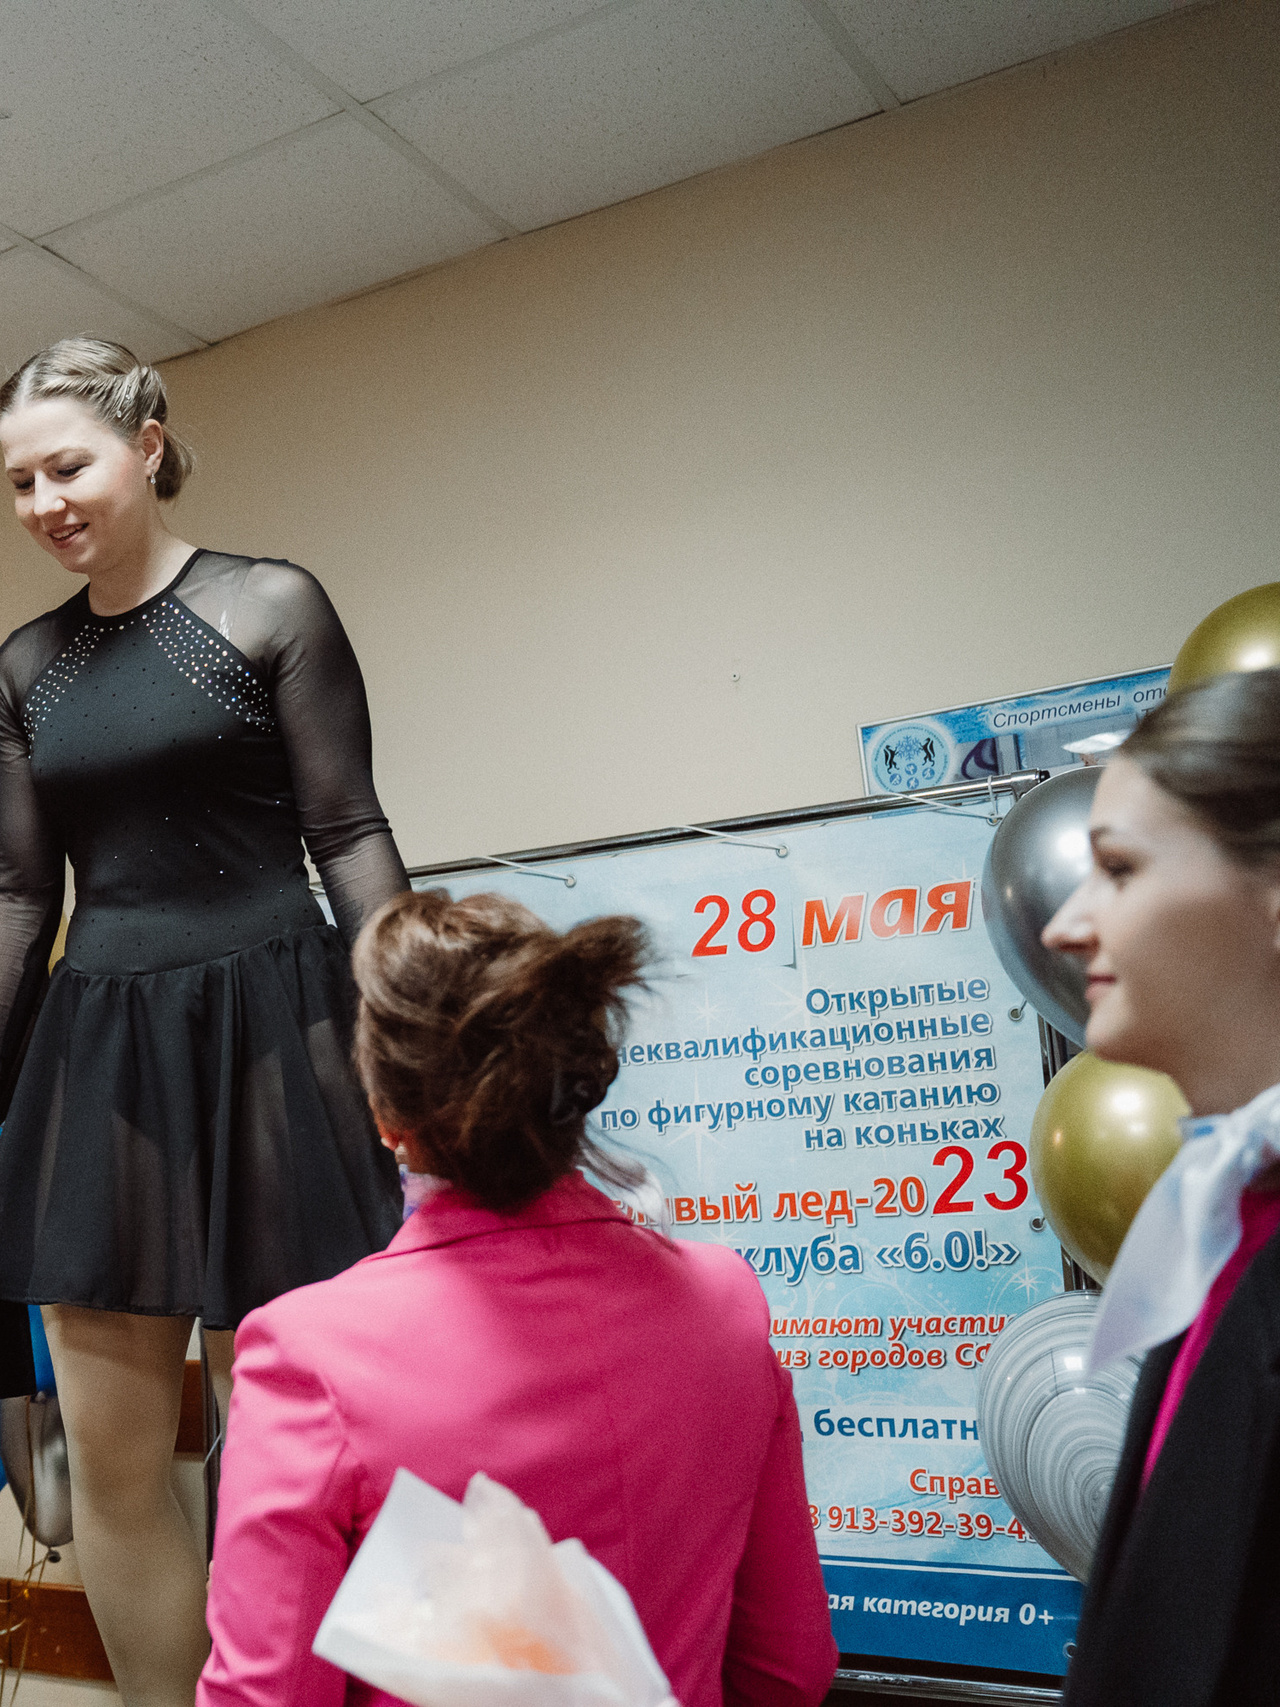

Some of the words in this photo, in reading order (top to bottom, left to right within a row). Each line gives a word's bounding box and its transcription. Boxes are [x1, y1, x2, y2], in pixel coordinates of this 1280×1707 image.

[992, 695, 1122, 728] Спортсмены
[691, 888, 777, 958] 28
[800, 880, 972, 947] мая
[805, 978, 988, 1018] Открытые
[744, 1046, 994, 1090] соревнования
[600, 1106, 638, 1130] по
[648, 1092, 833, 1130] фигурному
[843, 1081, 999, 1113] катанию
[804, 1126, 844, 1149] на
[855, 1116, 1005, 1146] коньках
[771, 1316, 880, 1336] имают
[887, 1315, 1013, 1341] участи
[818, 1342, 944, 1373] городов
[813, 1408, 980, 1441] бесплатн
[909, 1468, 1000, 1501] Справ
[827, 1505, 1035, 1541] 913-392-39-4
[827, 1593, 855, 1611] ая
[862, 1596, 1010, 1626] категория
[1018, 1602, 1055, 1626] 0+
